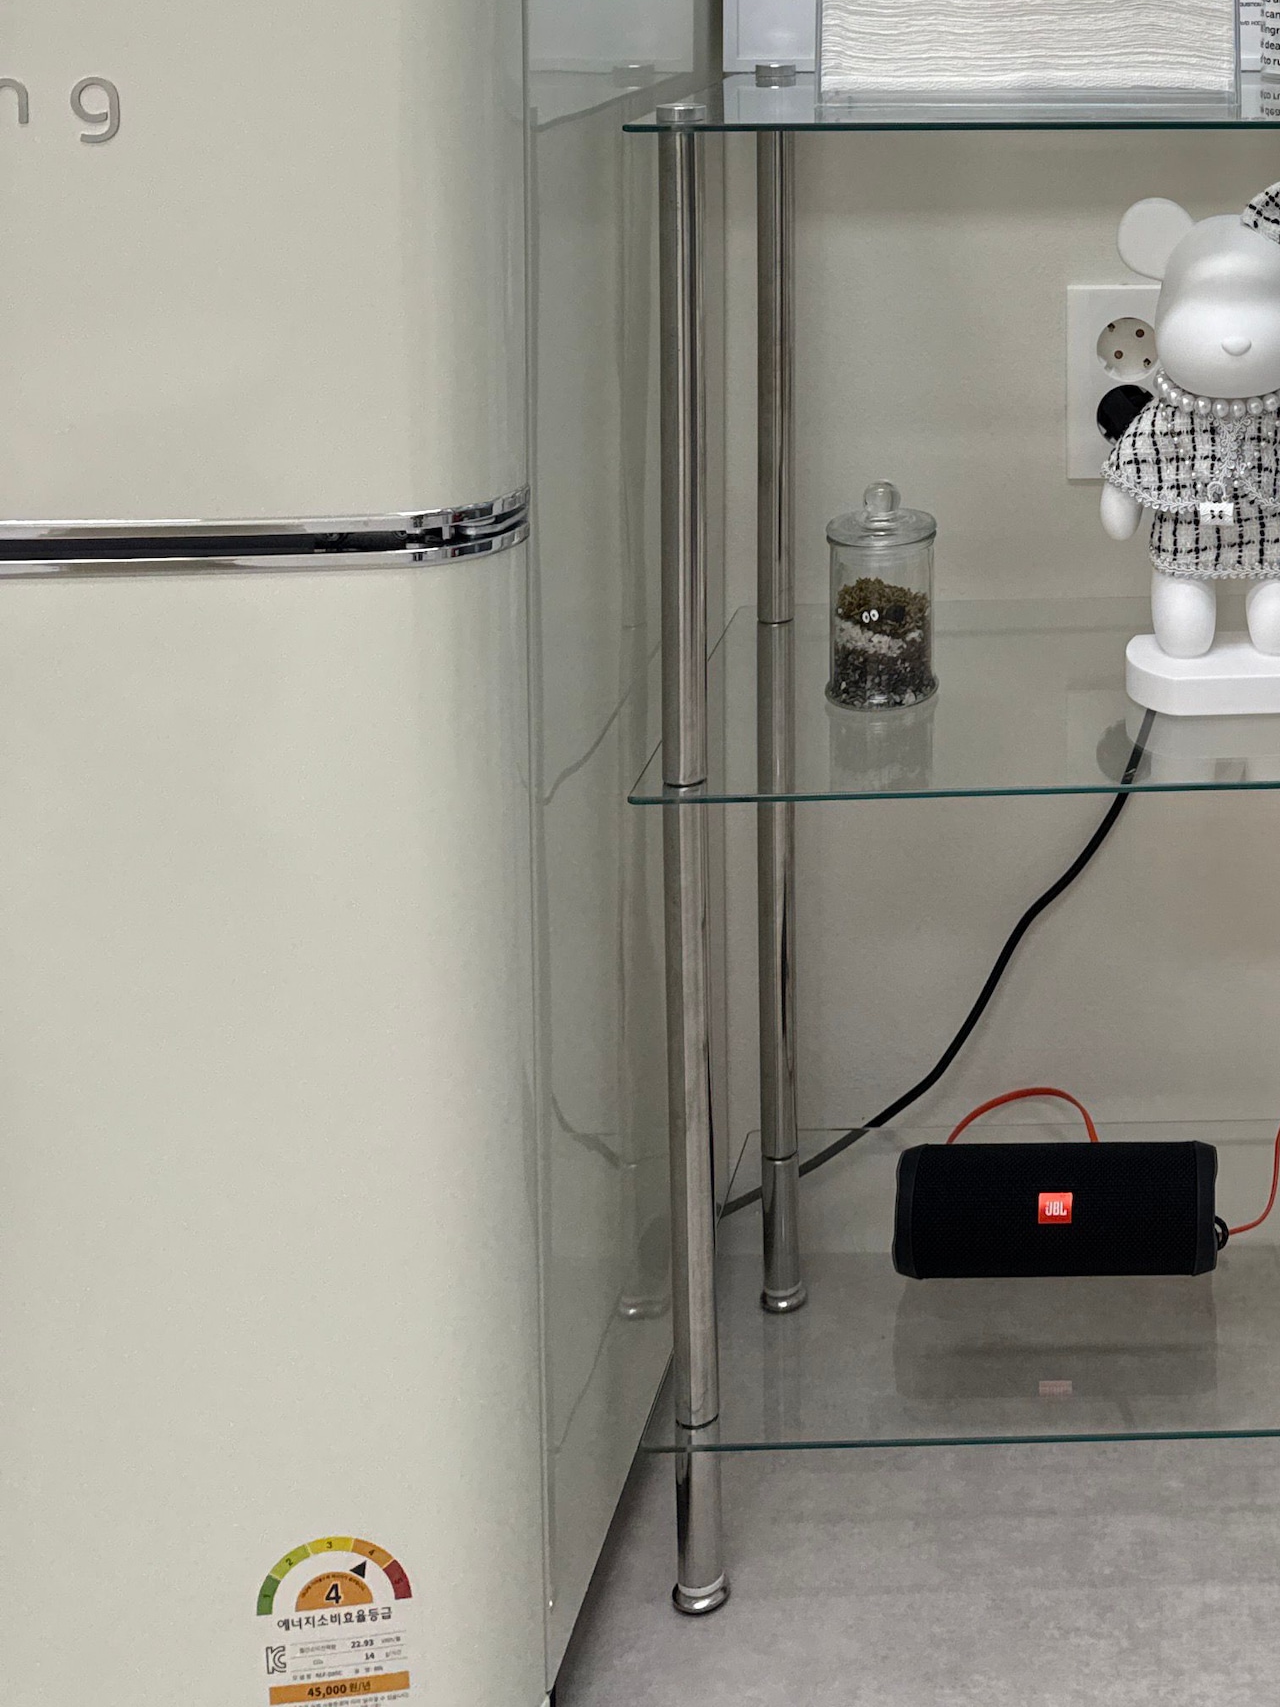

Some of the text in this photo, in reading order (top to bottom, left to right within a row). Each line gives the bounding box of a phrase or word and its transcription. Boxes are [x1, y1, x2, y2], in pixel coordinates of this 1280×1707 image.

[1045, 1201, 1067, 1216] JBL
[326, 1541, 333, 1549] 3
[285, 1558, 294, 1567] 2
[325, 1583, 342, 1604] 4
[277, 1606, 392, 1631] 에너지소비효율등급
[350, 1639, 374, 1649] 22.93
[365, 1652, 375, 1661] 14
[307, 1681, 371, 1698] 45,000 원/년
